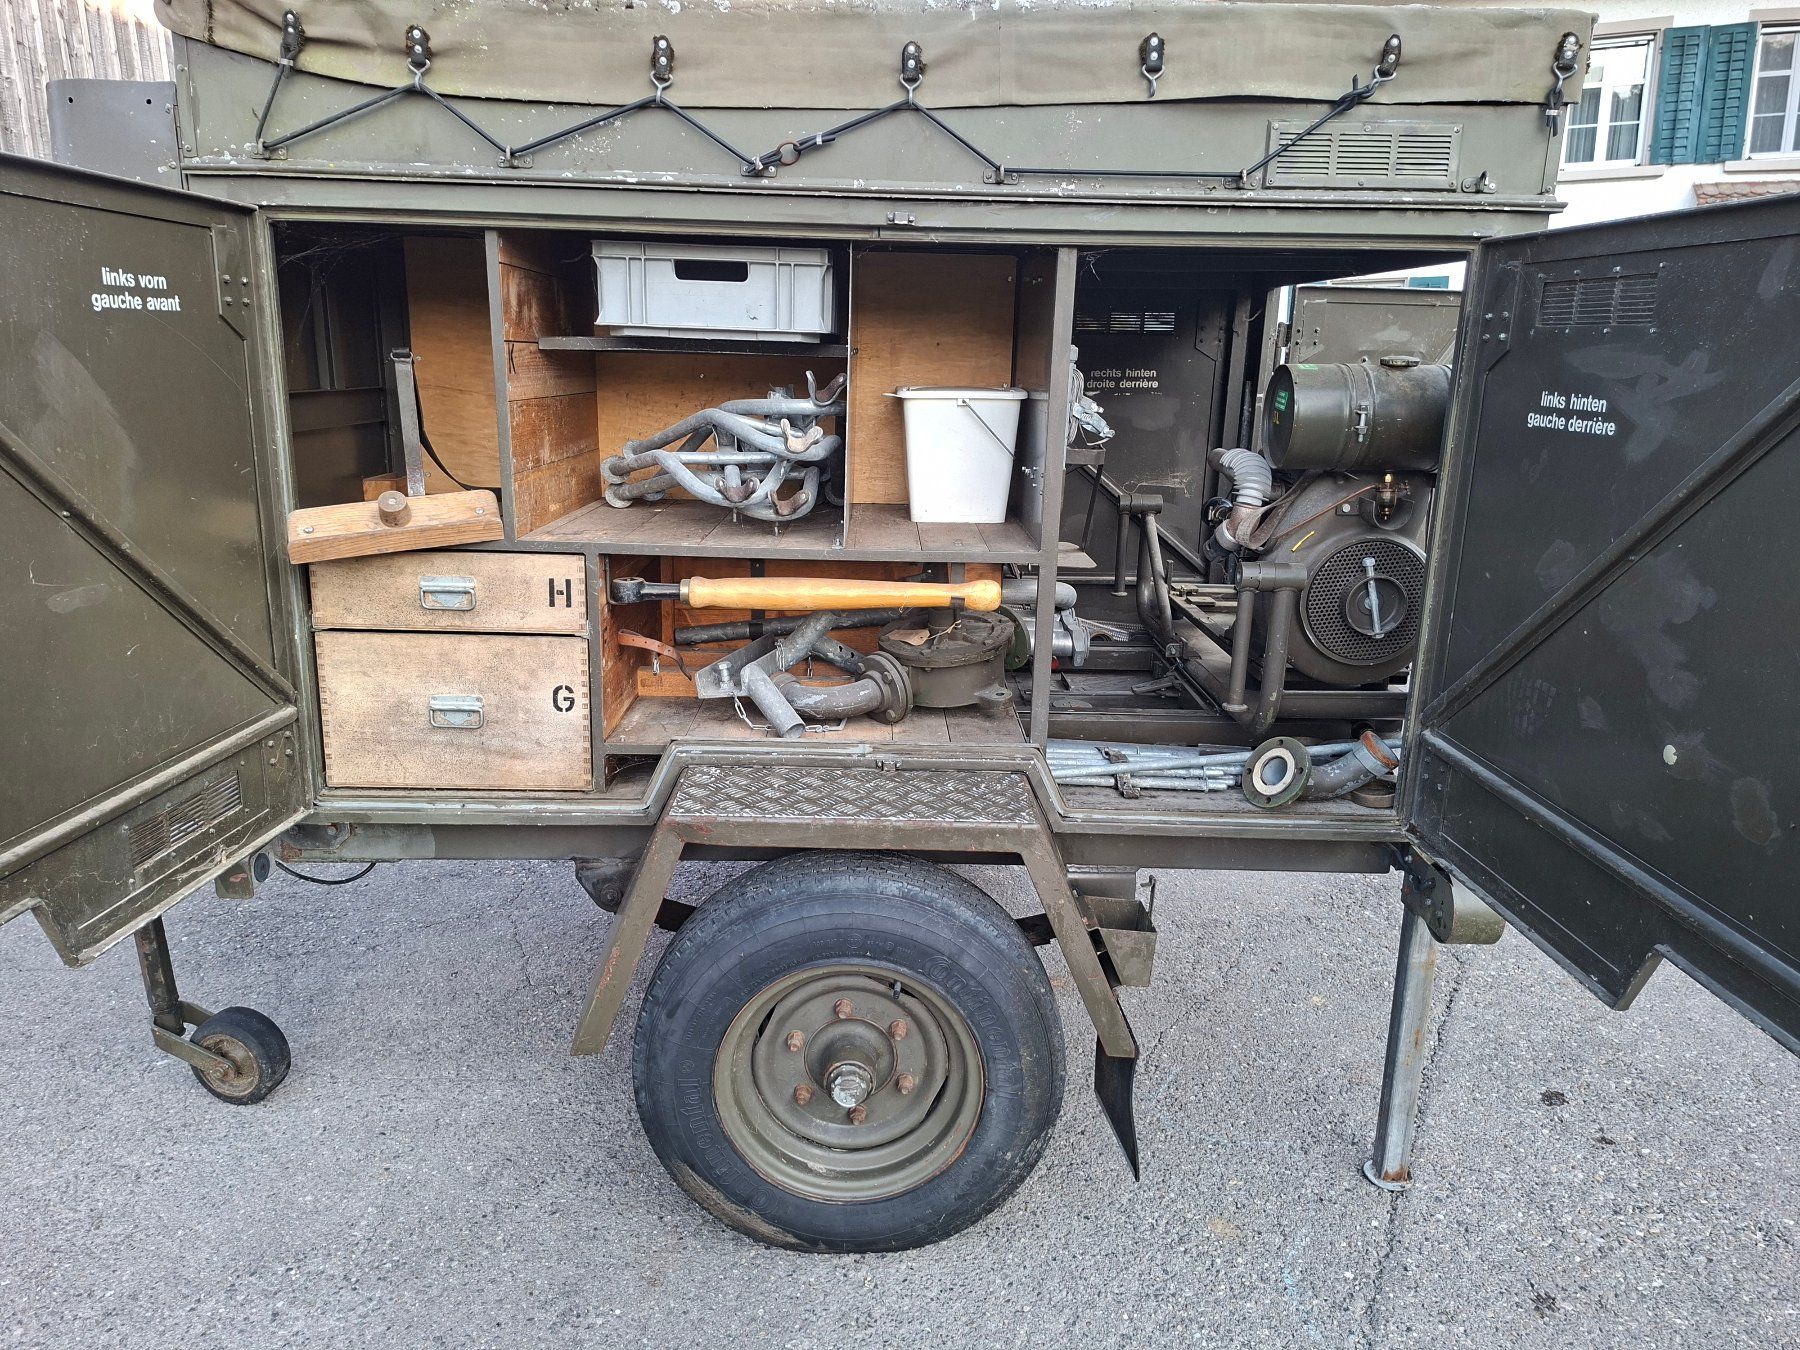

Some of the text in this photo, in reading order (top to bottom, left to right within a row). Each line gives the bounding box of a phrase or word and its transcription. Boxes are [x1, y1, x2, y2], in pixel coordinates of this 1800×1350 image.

[101, 266, 167, 289] links vorn
[91, 291, 181, 311] gauche avant
[1086, 378, 1159, 389] droite derrière
[1090, 368, 1157, 378] rechts hinten
[1540, 391, 1607, 412] links hinten
[1527, 412, 1616, 435] gauche derrière
[548, 577, 572, 608] H
[552, 684, 575, 713] G
[923, 955, 1023, 1100] Continental
[676, 1077, 779, 1215] Continental
